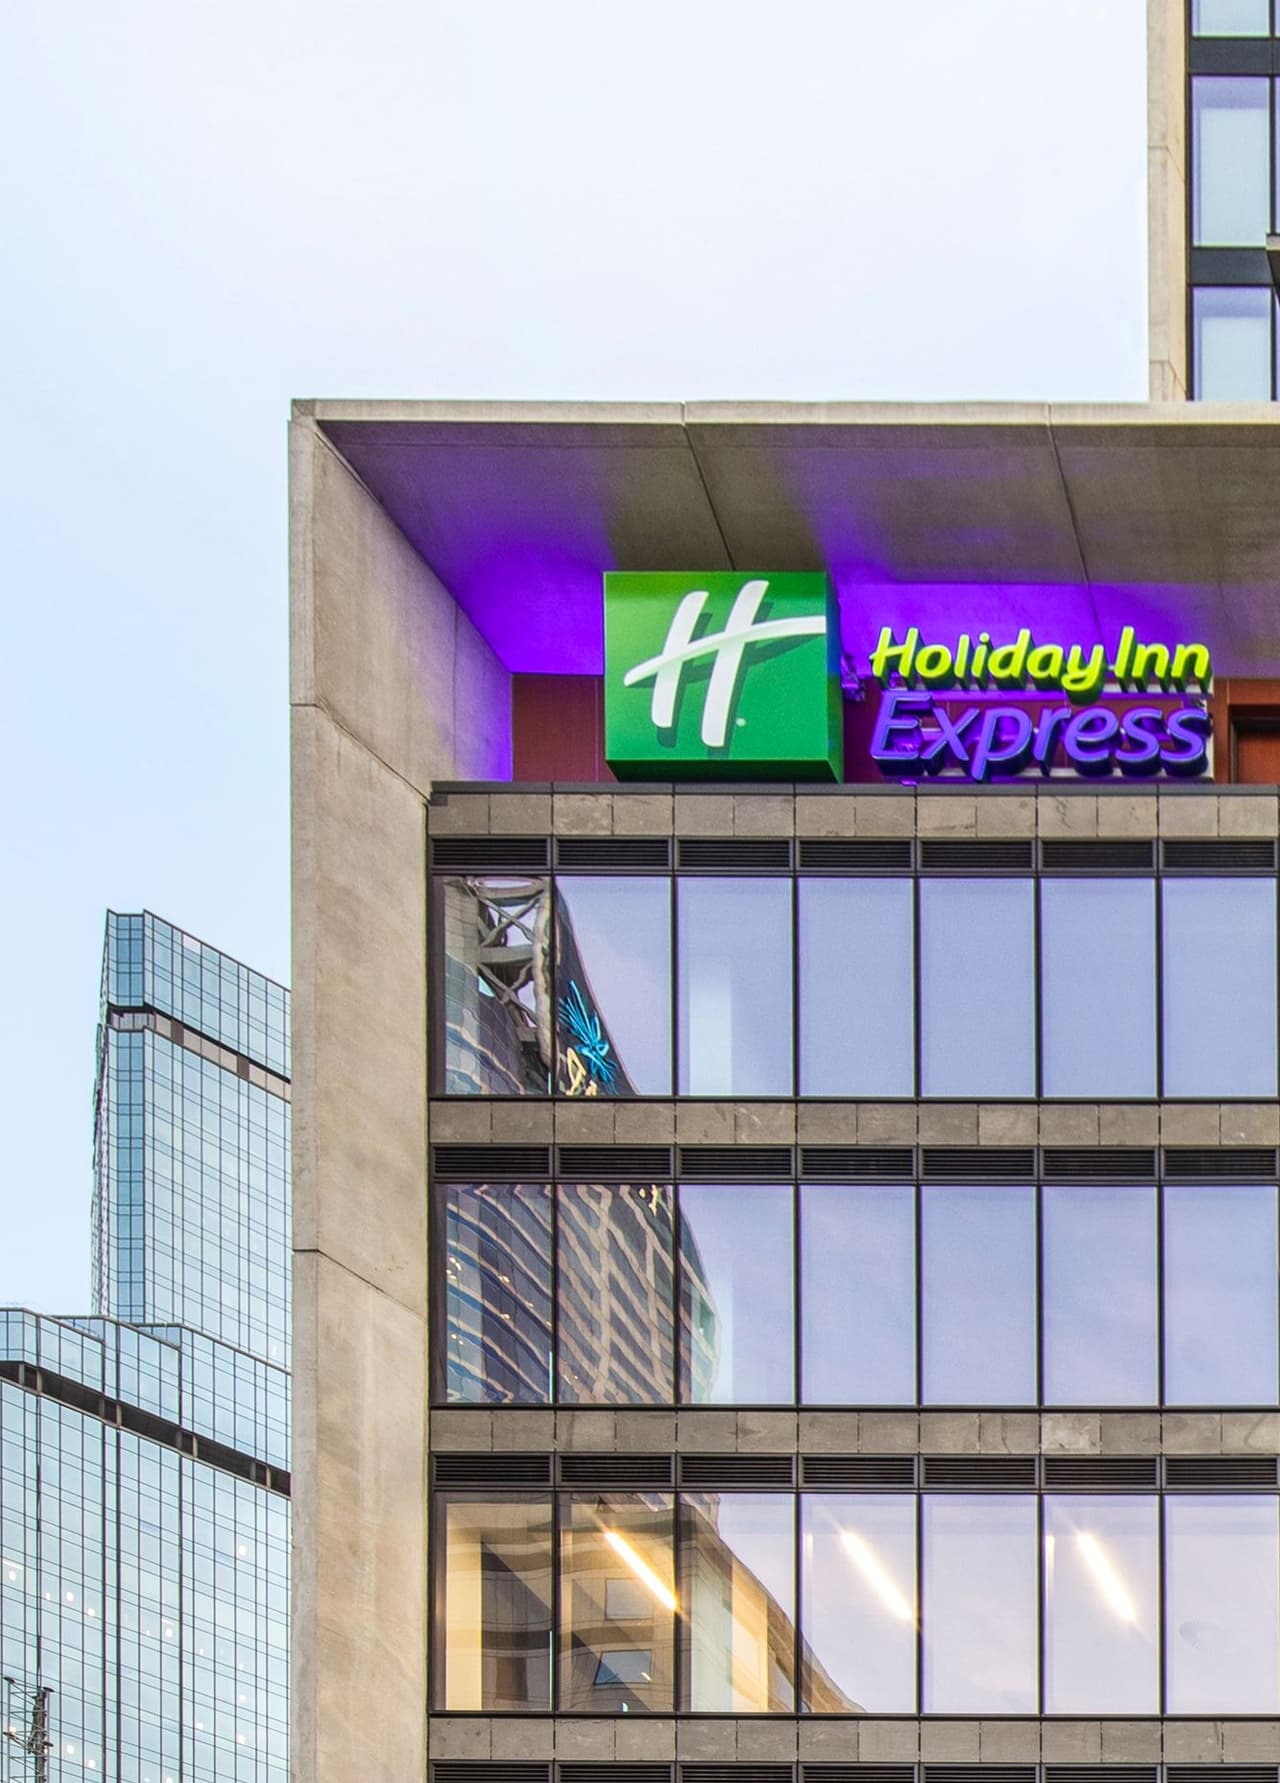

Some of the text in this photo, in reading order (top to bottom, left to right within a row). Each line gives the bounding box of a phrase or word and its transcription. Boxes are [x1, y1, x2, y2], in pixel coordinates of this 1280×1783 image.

[869, 626, 1211, 692] Holiday Inn
[870, 692, 1209, 781] Express
